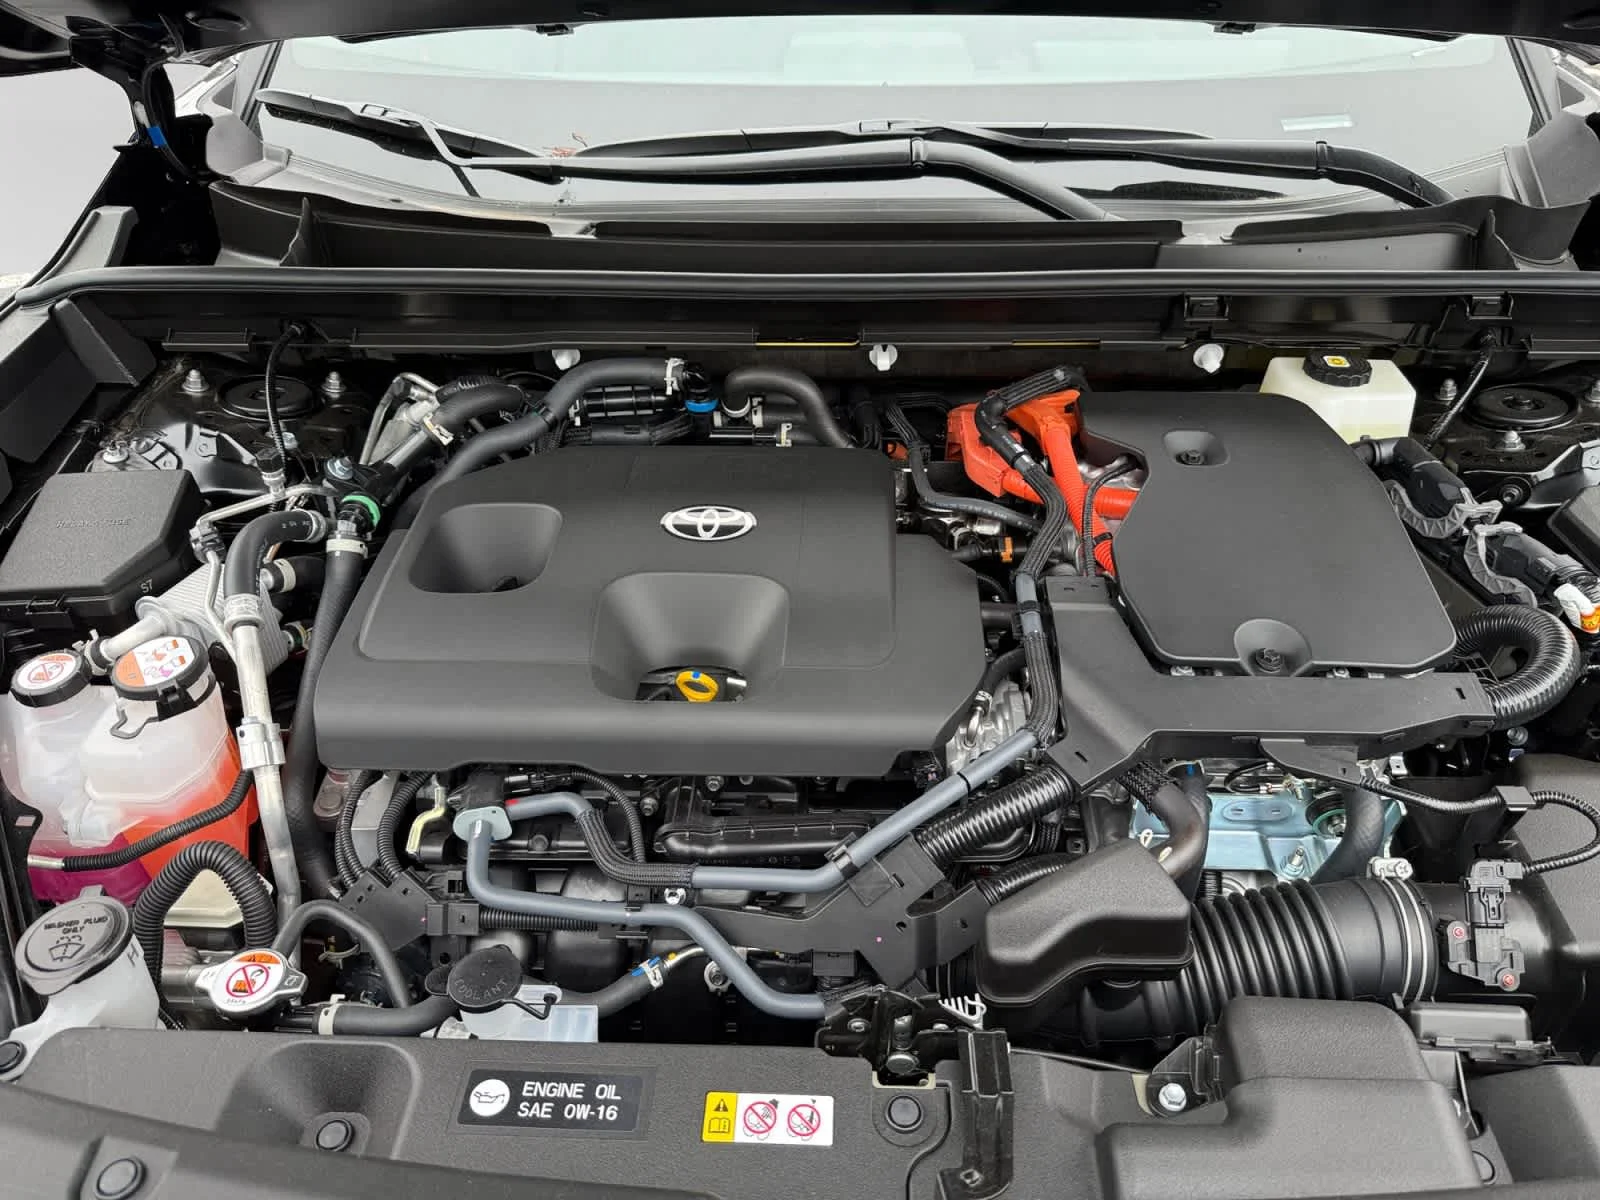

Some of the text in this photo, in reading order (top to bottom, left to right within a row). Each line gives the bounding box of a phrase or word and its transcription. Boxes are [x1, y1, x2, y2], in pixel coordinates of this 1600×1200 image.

[454, 978, 507, 1000] COOLANT
[522, 1081, 622, 1100] ENGINE OIL
[517, 1102, 618, 1120] SAE 0W-16
